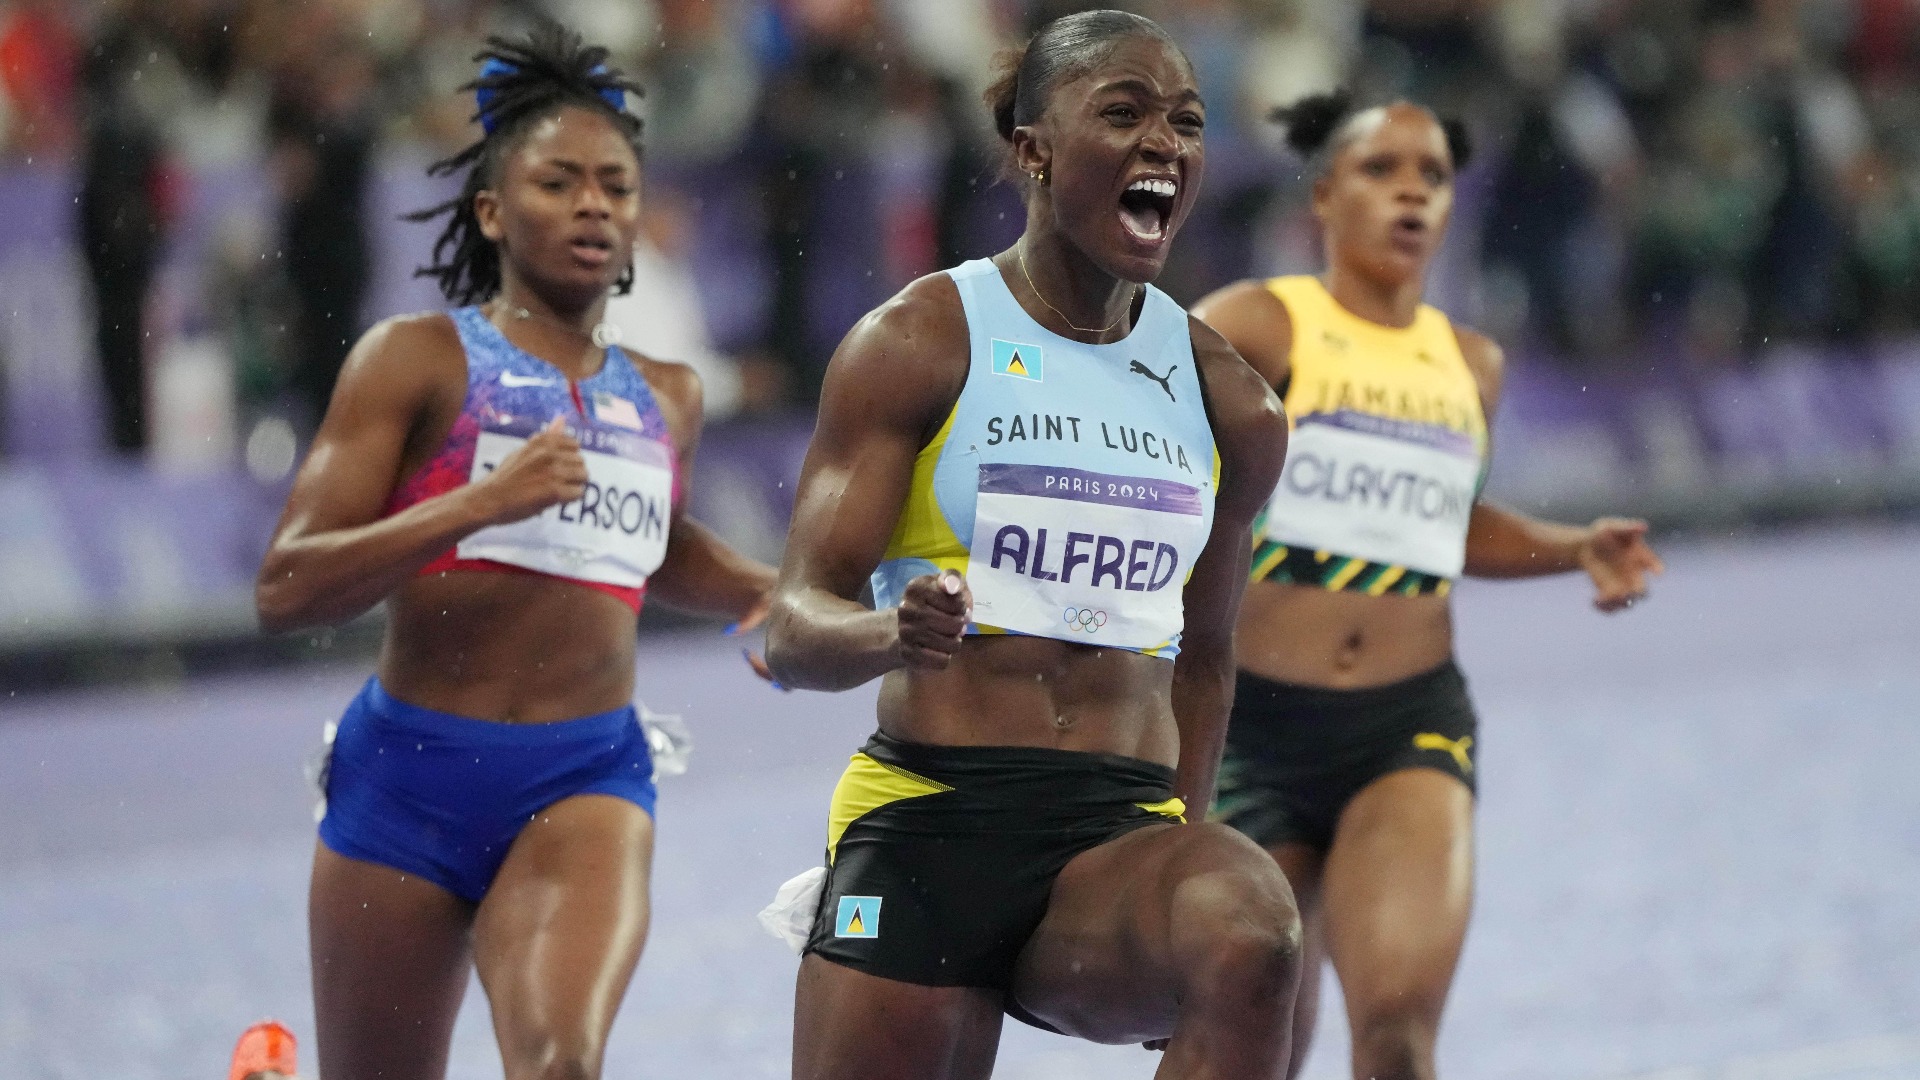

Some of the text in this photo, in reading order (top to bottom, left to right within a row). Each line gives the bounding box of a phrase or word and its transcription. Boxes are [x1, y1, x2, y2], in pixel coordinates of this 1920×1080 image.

[987, 413, 1193, 475] SAINT LUCIA
[1107, 483, 1158, 501] 2024
[990, 524, 1179, 592] ALFRED
